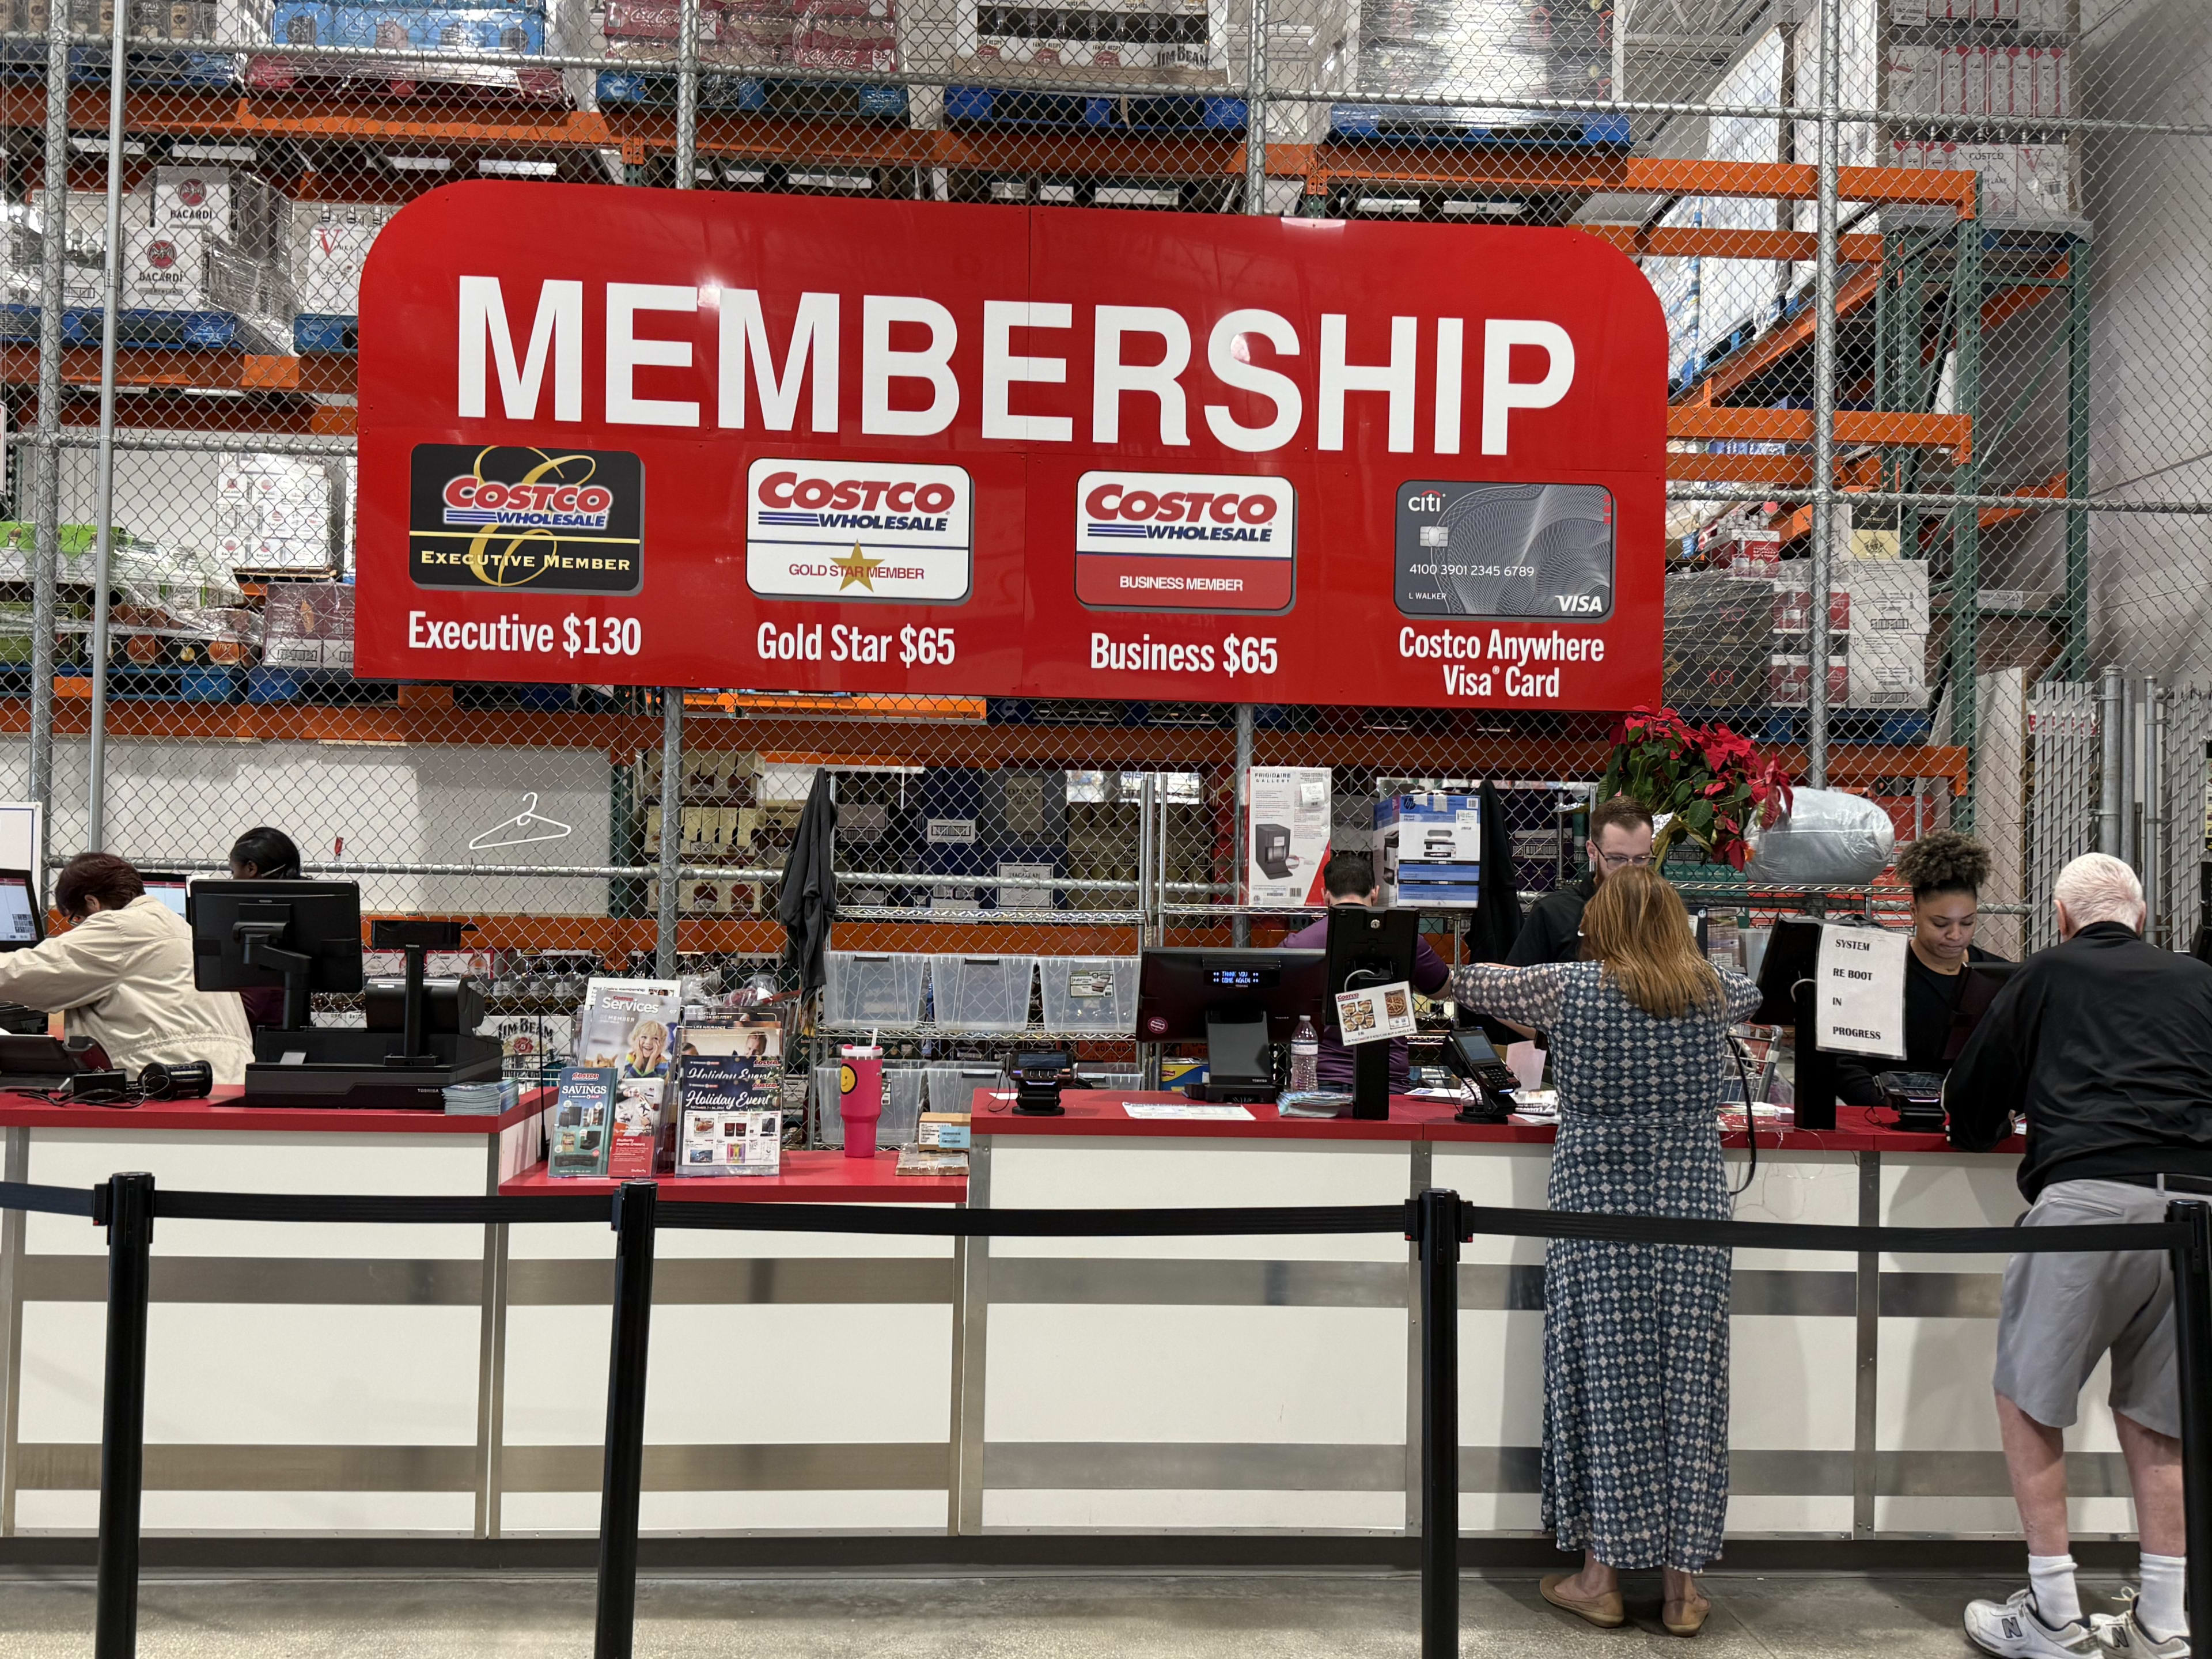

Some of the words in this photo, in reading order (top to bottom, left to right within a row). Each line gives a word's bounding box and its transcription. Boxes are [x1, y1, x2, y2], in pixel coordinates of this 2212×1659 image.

[457, 275, 1575, 456] MEMBERSHIP
[445, 477, 611, 513] COSTCO
[758, 471, 955, 514] COSTCO
[1408, 490, 1441, 512] citi
[1085, 484, 1277, 525] COSTCO
[497, 512, 606, 527] WHOLESALE
[819, 513, 948, 532] WHOLESALE
[1145, 525, 1272, 542] WHOLESALE
[421, 550, 535, 567] EXECUTIVE
[544, 555, 630, 570] MEMBER
[789, 564, 827, 576] GOLD
[830, 565, 863, 578] STAR
[866, 567, 924, 579] MEMBER
[1410, 564, 1437, 575] 4100
[1441, 565, 1468, 575] 3901
[1471, 565, 1500, 576] 2345
[1503, 566, 1534, 577] 6789
[1119, 576, 1184, 589] BUSINESS
[1186, 578, 1243, 592] MEMBER
[1555, 595, 1603, 612] VISA
[409, 610, 554, 652] Executive
[562, 612, 642, 658] $130
[757, 622, 823, 661] Gold
[830, 624, 892, 662] Star
[899, 623, 955, 669] $65
[1090, 632, 1215, 672] Business
[1222, 633, 1278, 678] $65
[1399, 626, 1480, 660] Costco
[1487, 628, 1604, 666] Anywhere
[1505, 666, 1560, 698] Card
[1707, 670, 1734, 685] XO
[1835, 939, 1870, 951] SYSTEM
[1833, 968, 1846, 978] RE
[1848, 970, 1873, 981] BOOT
[601, 997, 659, 1013] Services
[1832, 997, 1842, 1006] IN
[1832, 1026, 1881, 1040] PROGRESS
[562, 1085, 607, 1094] SAVINGS
[685, 1090, 736, 1109] Holiday
[736, 1092, 771, 1107] Event
[2001, 1616, 2023, 1639] N
[2111, 1626, 2130, 1648] N
